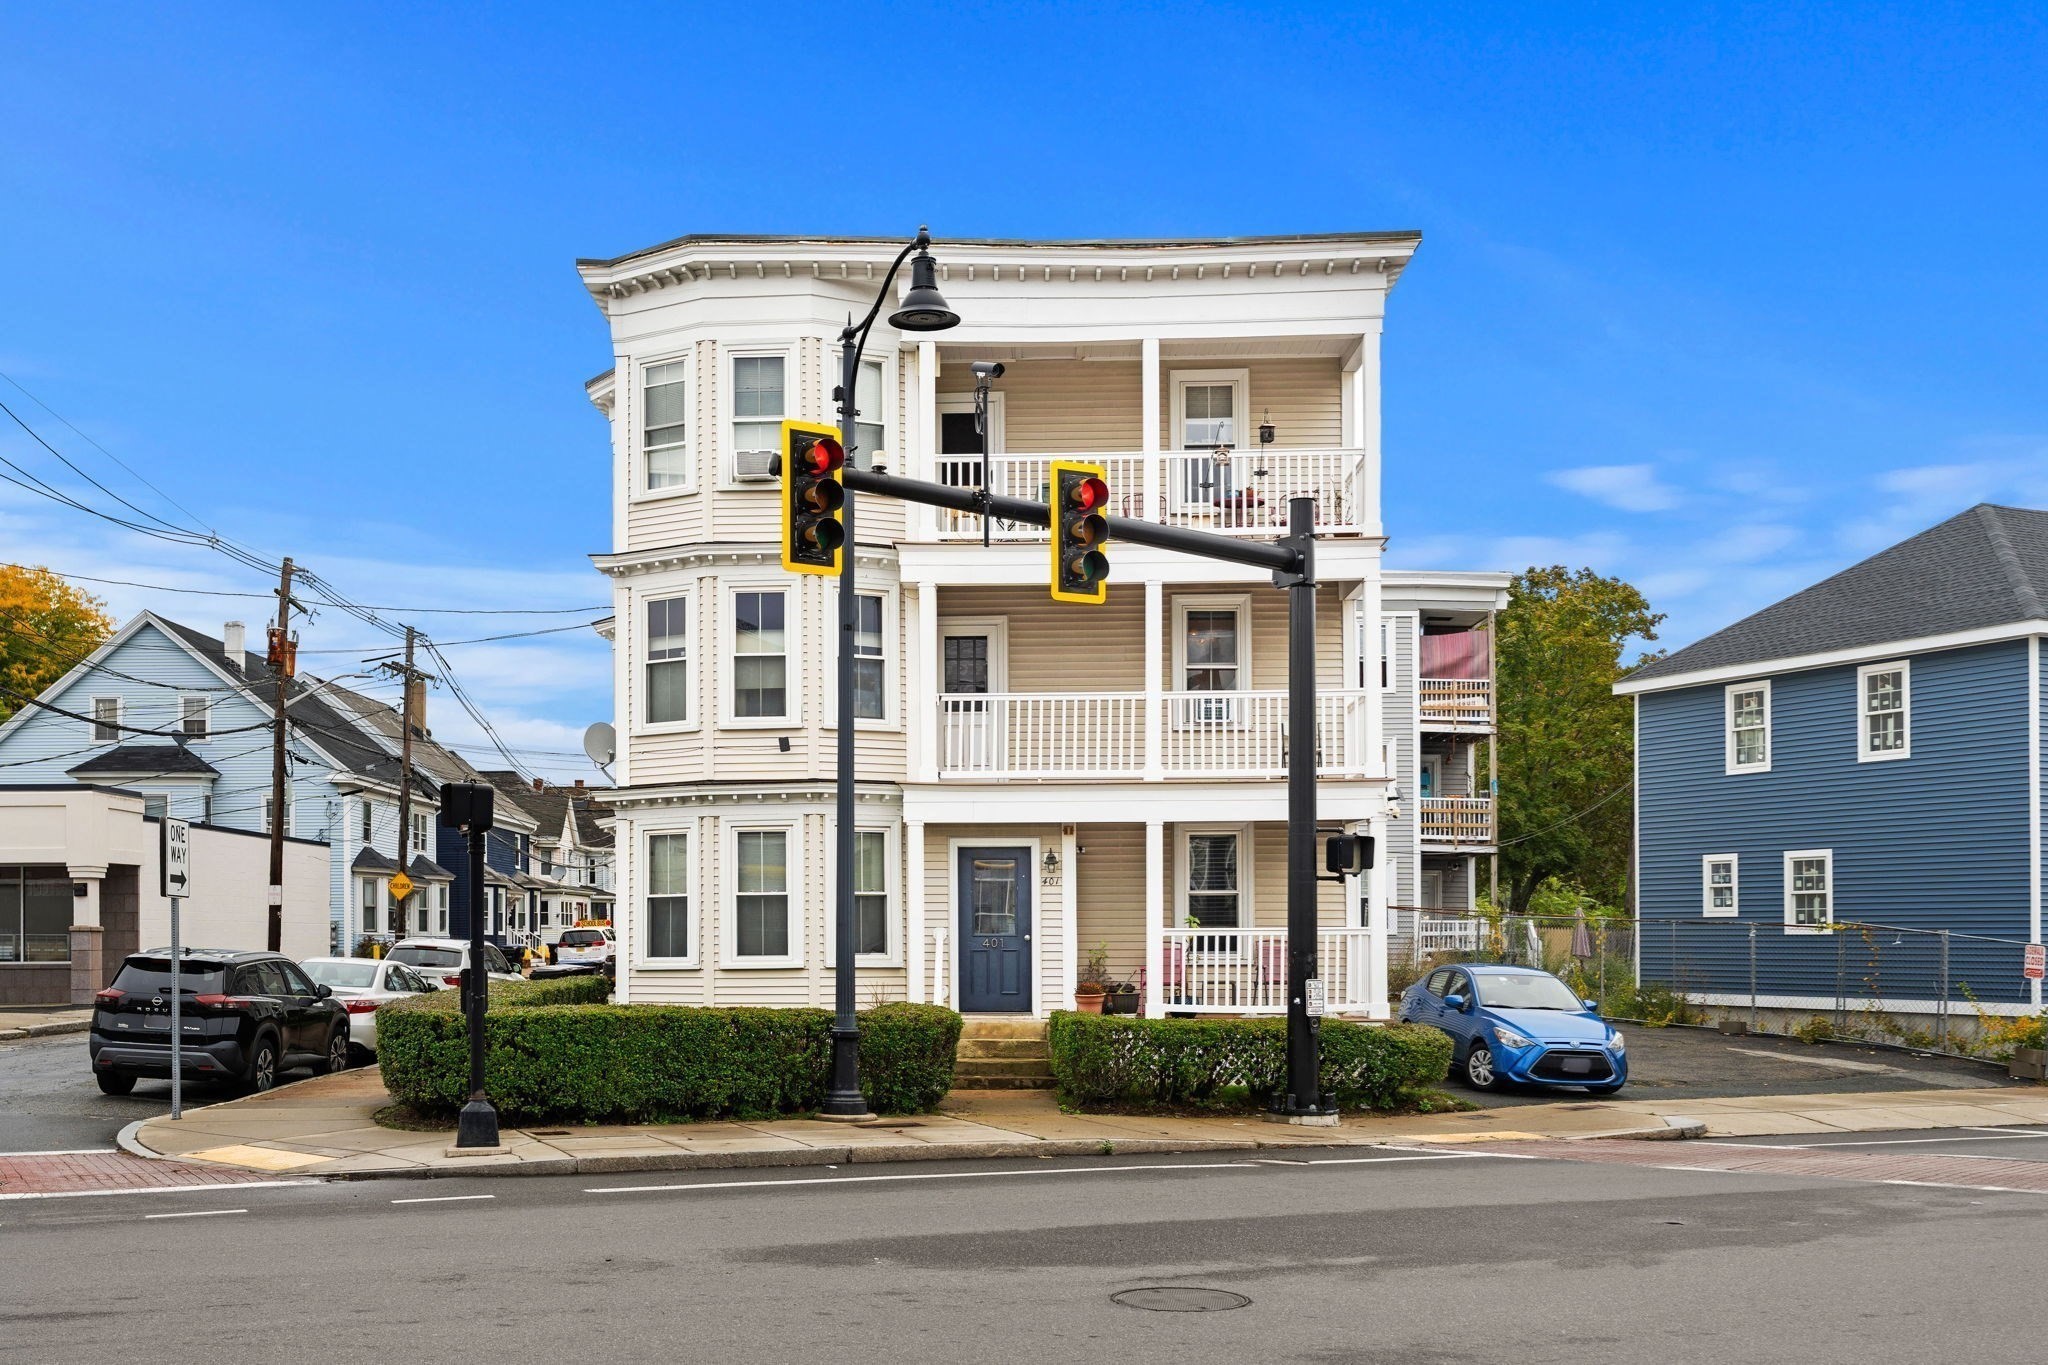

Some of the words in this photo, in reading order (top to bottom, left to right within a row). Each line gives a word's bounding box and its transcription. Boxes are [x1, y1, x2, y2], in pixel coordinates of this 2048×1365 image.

[170, 824, 186, 843] ONE
[170, 845, 186, 864] WAY
[389, 882, 411, 890] CHILDREN
[1042, 877, 1060, 886] 401
[982, 938, 1005, 948] 401
[2025, 946, 2044, 955] SIDEWALK
[2025, 956, 2044, 967] CLOSED
